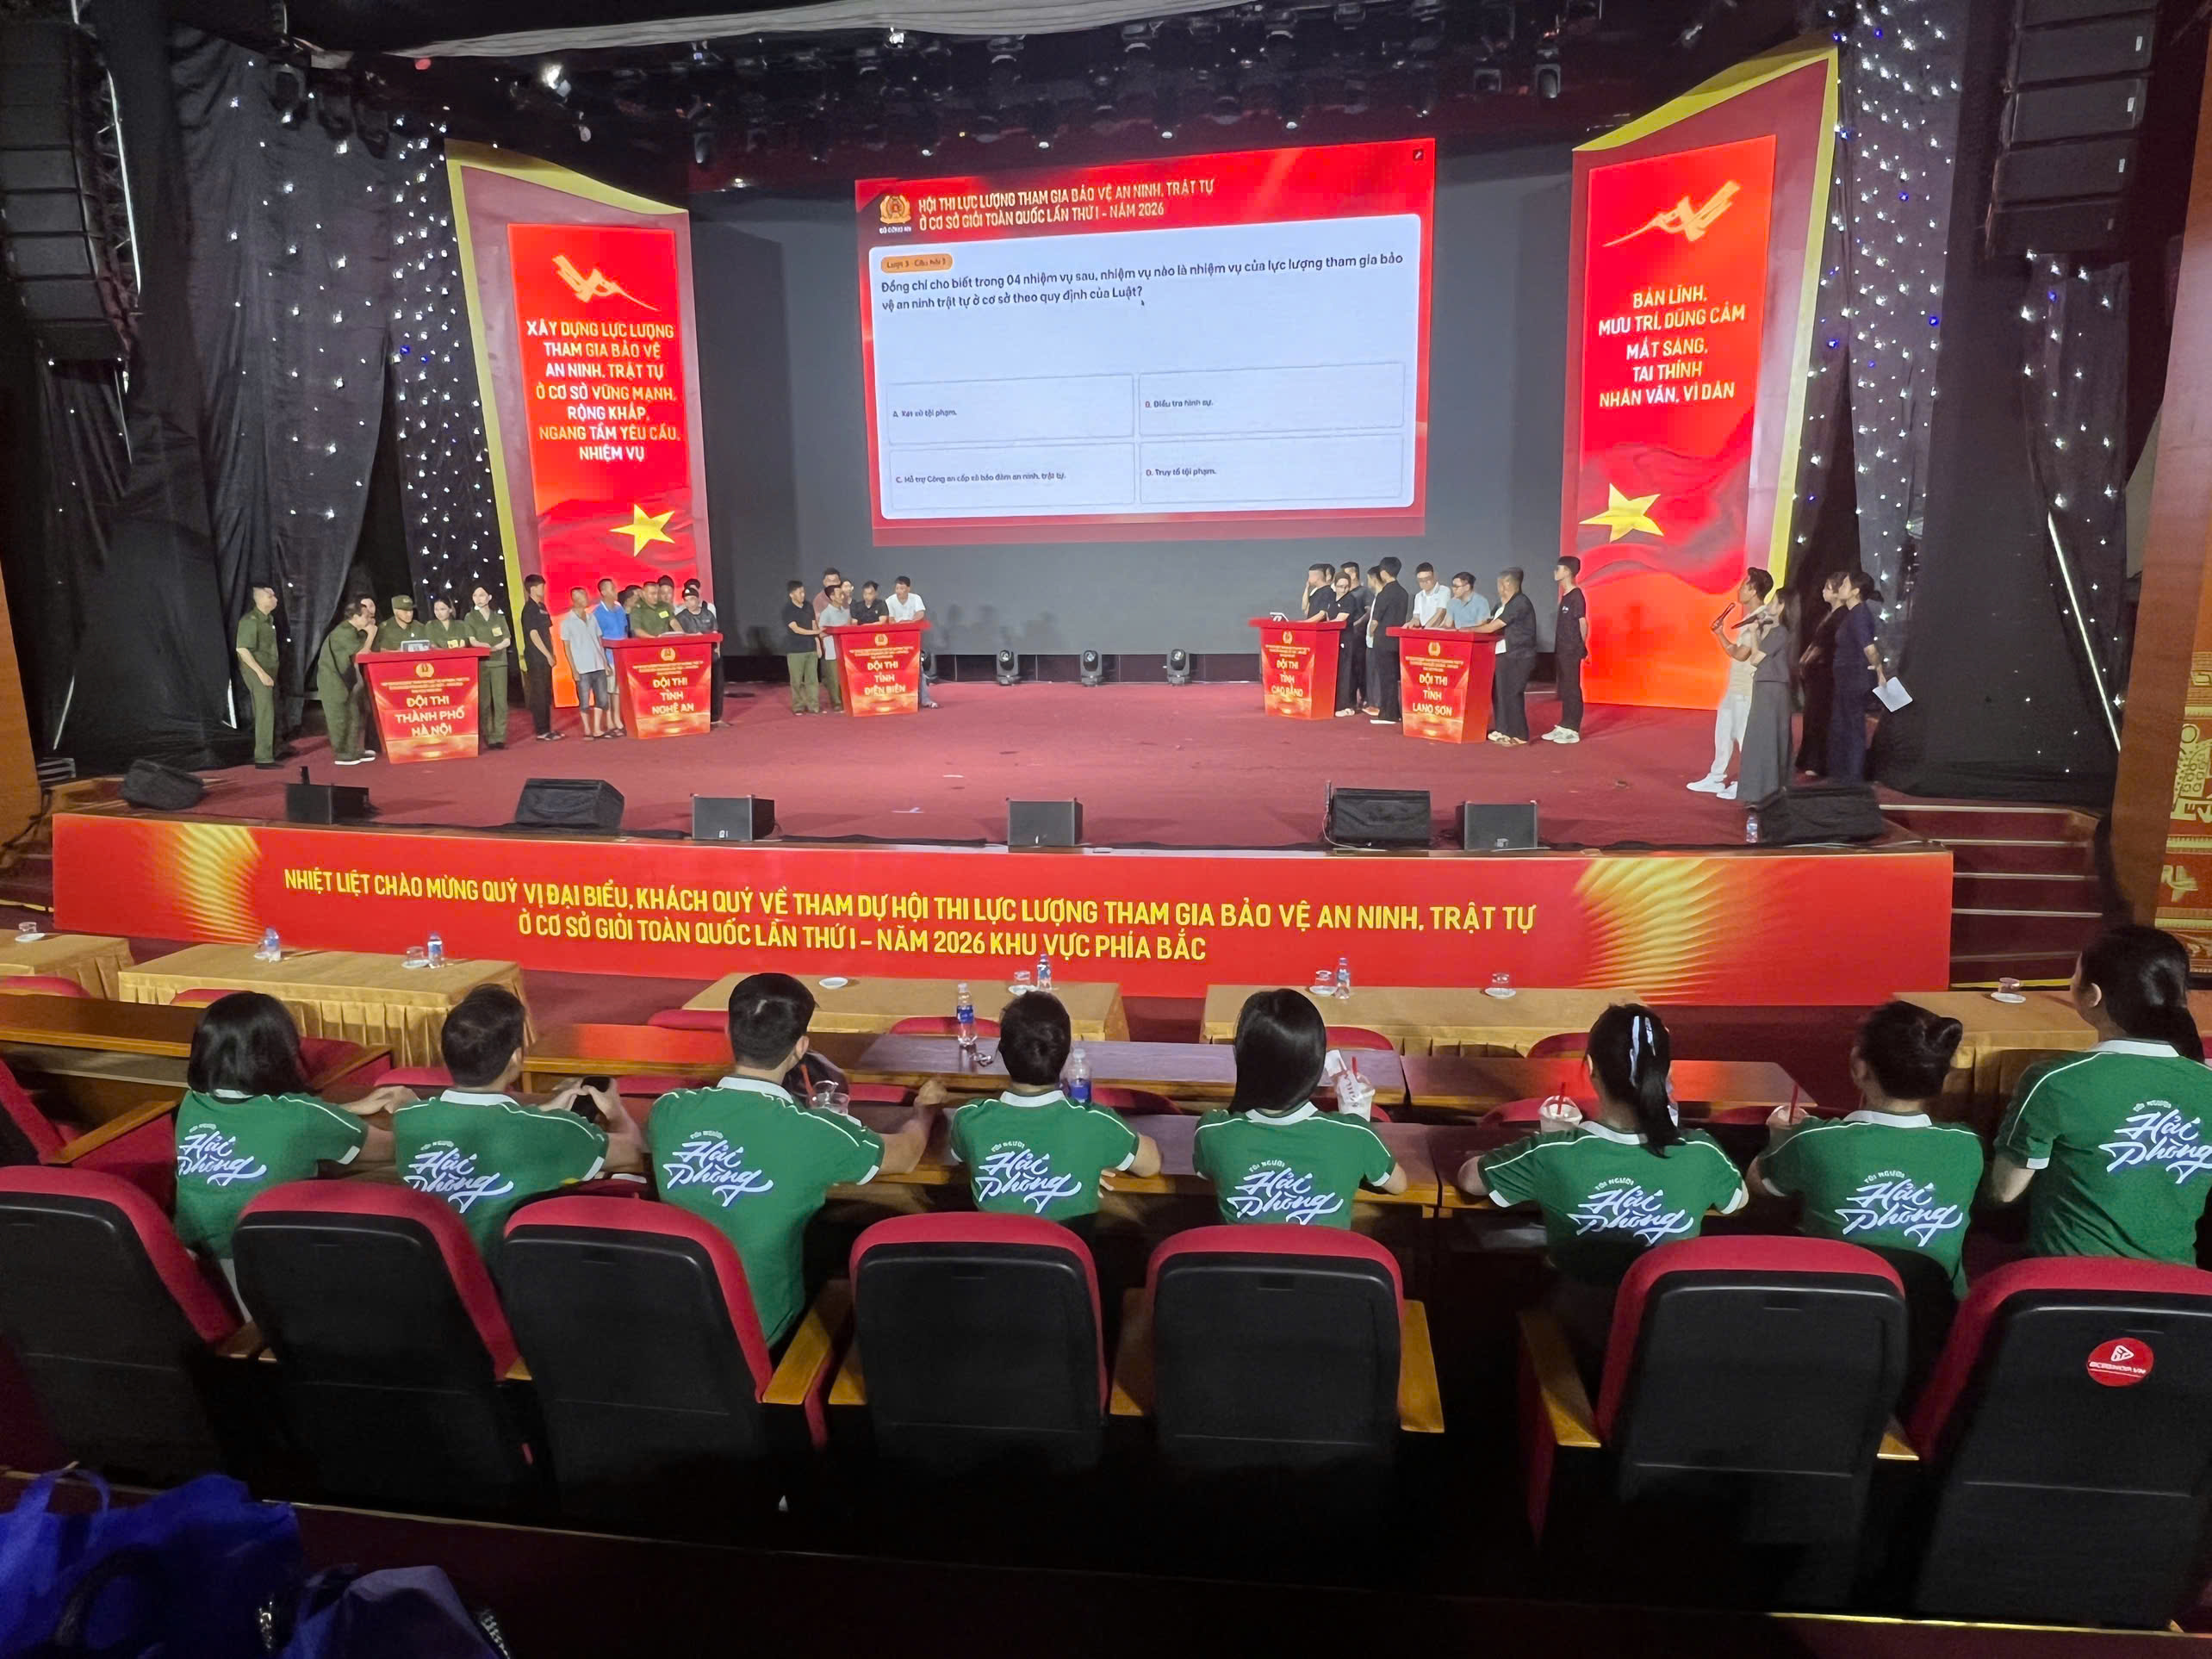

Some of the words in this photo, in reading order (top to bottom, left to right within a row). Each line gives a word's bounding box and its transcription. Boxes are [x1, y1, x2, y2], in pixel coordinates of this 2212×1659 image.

[939, 197, 955, 212] THI
[1018, 190, 1048, 206] THAM
[1051, 189, 1069, 203] GIA
[1115, 185, 1131, 199] AN
[1139, 202, 1164, 216] 2026
[930, 278, 949, 289] cho
[975, 277, 1004, 289] trong
[1007, 274, 1021, 285] 04
[1023, 272, 1057, 286] nhiệm
[1059, 274, 1073, 284] vụ
[1138, 270, 1152, 280] vụ
[1177, 264, 1187, 276] là
[1228, 264, 1241, 276] vụ
[1289, 258, 1323, 271] lượng
[1326, 257, 1357, 267] tham
[1359, 254, 1376, 268] gia
[1380, 252, 1403, 264] bảo
[897, 301, 910, 310] an
[912, 298, 935, 308] ninh
[1013, 292, 1037, 303] theo
[1040, 293, 1060, 303] quy
[1633, 287, 1665, 308] BẢN
[526, 318, 557, 336] XÂY
[1664, 308, 1706, 329] DŨNG
[1710, 301, 1745, 324] CẢM
[544, 342, 582, 357] THAM
[586, 343, 608, 357] GIA
[611, 339, 639, 357] BẢO
[545, 363, 565, 377] AN
[1632, 365, 1654, 382] TAI
[1657, 360, 1703, 380] THÍNH
[1600, 388, 1642, 407] NHÂN
[1701, 380, 1735, 401] DÂN
[568, 403, 606, 422] RỘNG
[539, 426, 587, 440] NGANG
[619, 426, 646, 440] YÊU
[579, 444, 623, 462] NHIỆM
[625, 446, 644, 462] VỤ
[672, 677, 687, 686] THI
[395, 709, 437, 724] THÀNH
[439, 705, 464, 720] PHỐ
[407, 695, 427, 709] ĐỘI
[430, 695, 449, 705] THI
[680, 703, 694, 712] AN
[284, 867, 333, 895] NHIỆT
[336, 869, 370, 896] LIỆT
[374, 872, 424, 898] CHÀO
[427, 874, 479, 901] MỪNG
[482, 878, 518, 904] QUÝ
[522, 883, 544, 909] VỊ
[547, 883, 580, 910] ĐẠI
[584, 879, 634, 910] BIỂU,
[636, 885, 707, 912] KHÁCH
[712, 886, 753, 913] QUÝ
[759, 885, 789, 915] VỀ
[792, 892, 853, 916] THAM
[857, 893, 887, 922] DỰ
[892, 892, 929, 923] HỘI
[934, 897, 969, 921] THI
[974, 896, 1017, 925] LỰC
[1022, 898, 1098, 927] LƯỢNG
[1103, 900, 1169, 926] THAM
[1175, 902, 1215, 928] GIA
[1220, 897, 1271, 929] BẢO
[1278, 899, 1311, 932] VỆ
[1316, 904, 1351, 929] AN
[1357, 905, 1424, 931] NINH,
[1430, 901, 1496, 934] TRẬT
[1501, 904, 1537, 935] TỰ
[519, 909, 531, 935] Ở
[536, 914, 562, 936] CƠ
[566, 910, 590, 938] SỞ
[595, 912, 633, 941] GIỎI
[637, 916, 690, 943] TOÀN
[695, 916, 751, 946] QUỐC
[755, 917, 798, 948] LẦN
[802, 923, 846, 948] THỨ
[849, 928, 855, 949] I
[877, 925, 929, 953] NĂM
[934, 930, 985, 954] 2026
[990, 932, 1037, 955] KHU
[1043, 933, 1090, 960] VỰC
[1095, 930, 1152, 959] PHÍA
[1156, 928, 1206, 960] BẮC
[2114, 1109, 2201, 1144] Hải
[178, 1130, 236, 1160] Hải
[672, 1140, 744, 1169] Hải
[177, 1153, 267, 1186] Phòng
[408, 1147, 477, 1179] Hải
[979, 1148, 1050, 1179] Hải
[662, 1162, 774, 1207] Phòng
[974, 1171, 1082, 1214] Phòng
[1234, 1167, 1313, 1198] Hải
[1846, 1178, 1934, 1210] Hải
[1226, 1190, 1344, 1225] Phòng
[1577, 1185, 1663, 1216] Hải
[1566, 1209, 1694, 1246] Phòng
[1834, 1202, 1963, 1247] Phòng
